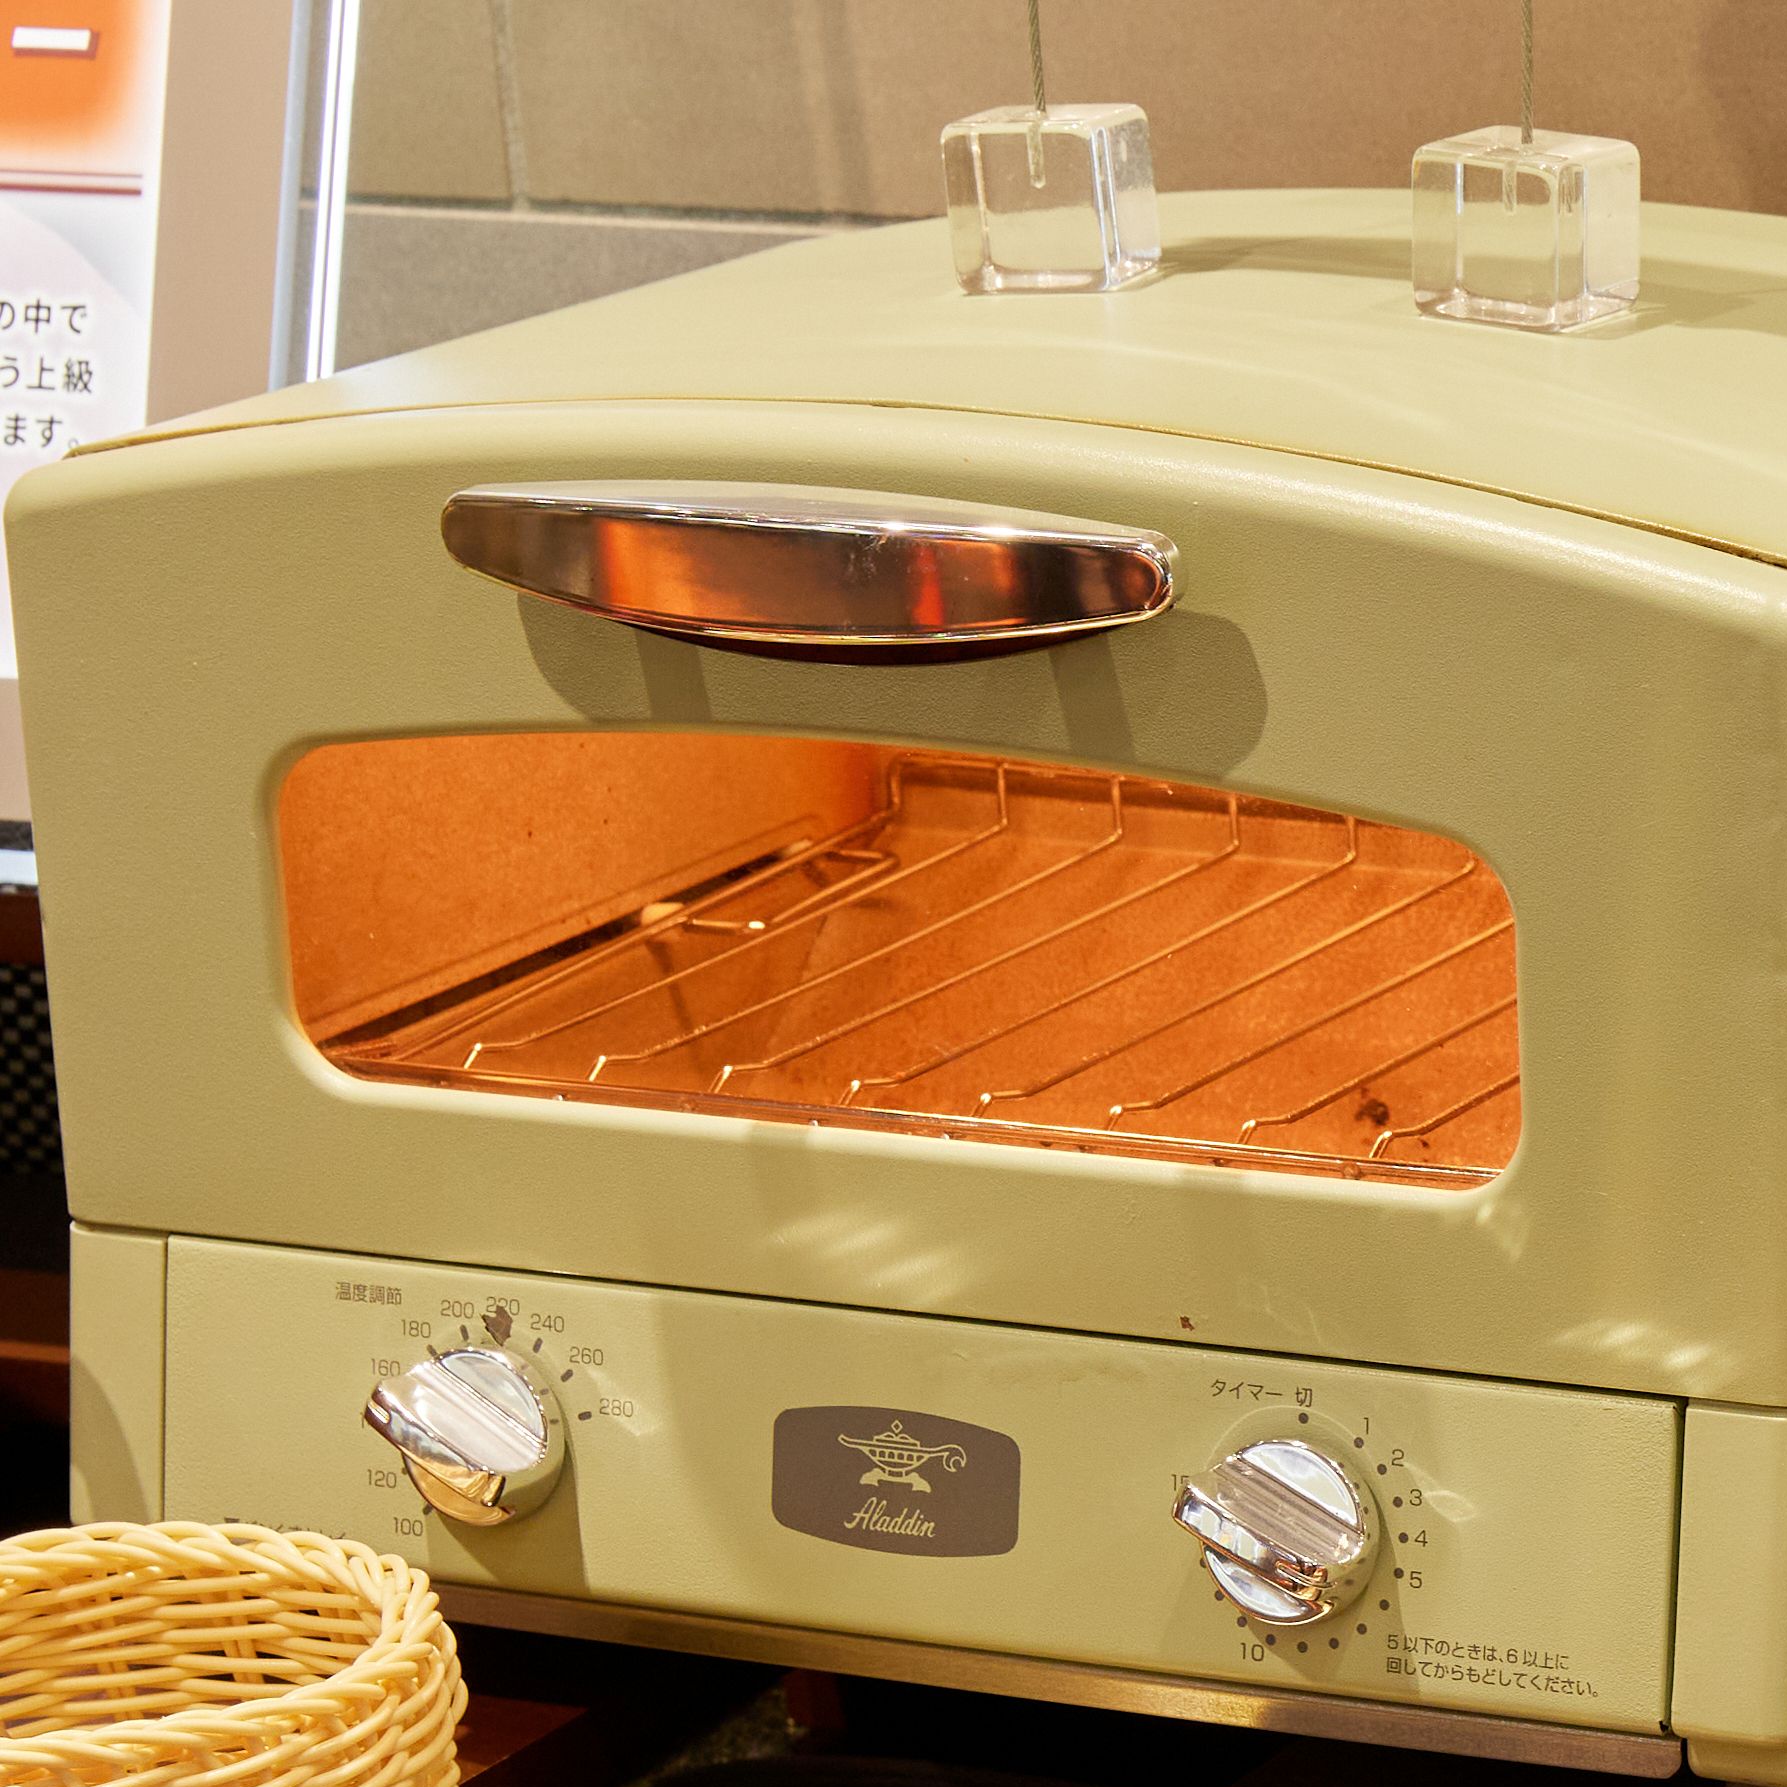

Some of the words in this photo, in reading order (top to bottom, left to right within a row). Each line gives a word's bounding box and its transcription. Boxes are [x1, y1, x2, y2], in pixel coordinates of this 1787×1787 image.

[0, 356, 93, 394] う上級
[334, 1281, 403, 1306] 温度調節
[440, 1299, 475, 1320] 200
[402, 1320, 431, 1339] 180
[530, 1313, 565, 1333] 240
[569, 1346, 604, 1366] 260
[371, 1358, 401, 1377] 160
[1210, 1378, 1283, 1402] タイマー
[1295, 1387, 1314, 1407] 切
[599, 1398, 634, 1418] 280
[1362, 1417, 1370, 1434] 1
[1391, 1449, 1405, 1467] 2
[367, 1468, 397, 1489] 120
[1409, 1489, 1423, 1507] 3
[393, 1516, 424, 1537] 100
[843, 1496, 936, 1538] Aladdin
[1414, 1529, 1429, 1547] 4
[1409, 1571, 1423, 1589] 5
[1240, 1642, 1265, 1663] 10
[1386, 1656, 1599, 1698] 回してからもどしてください。
